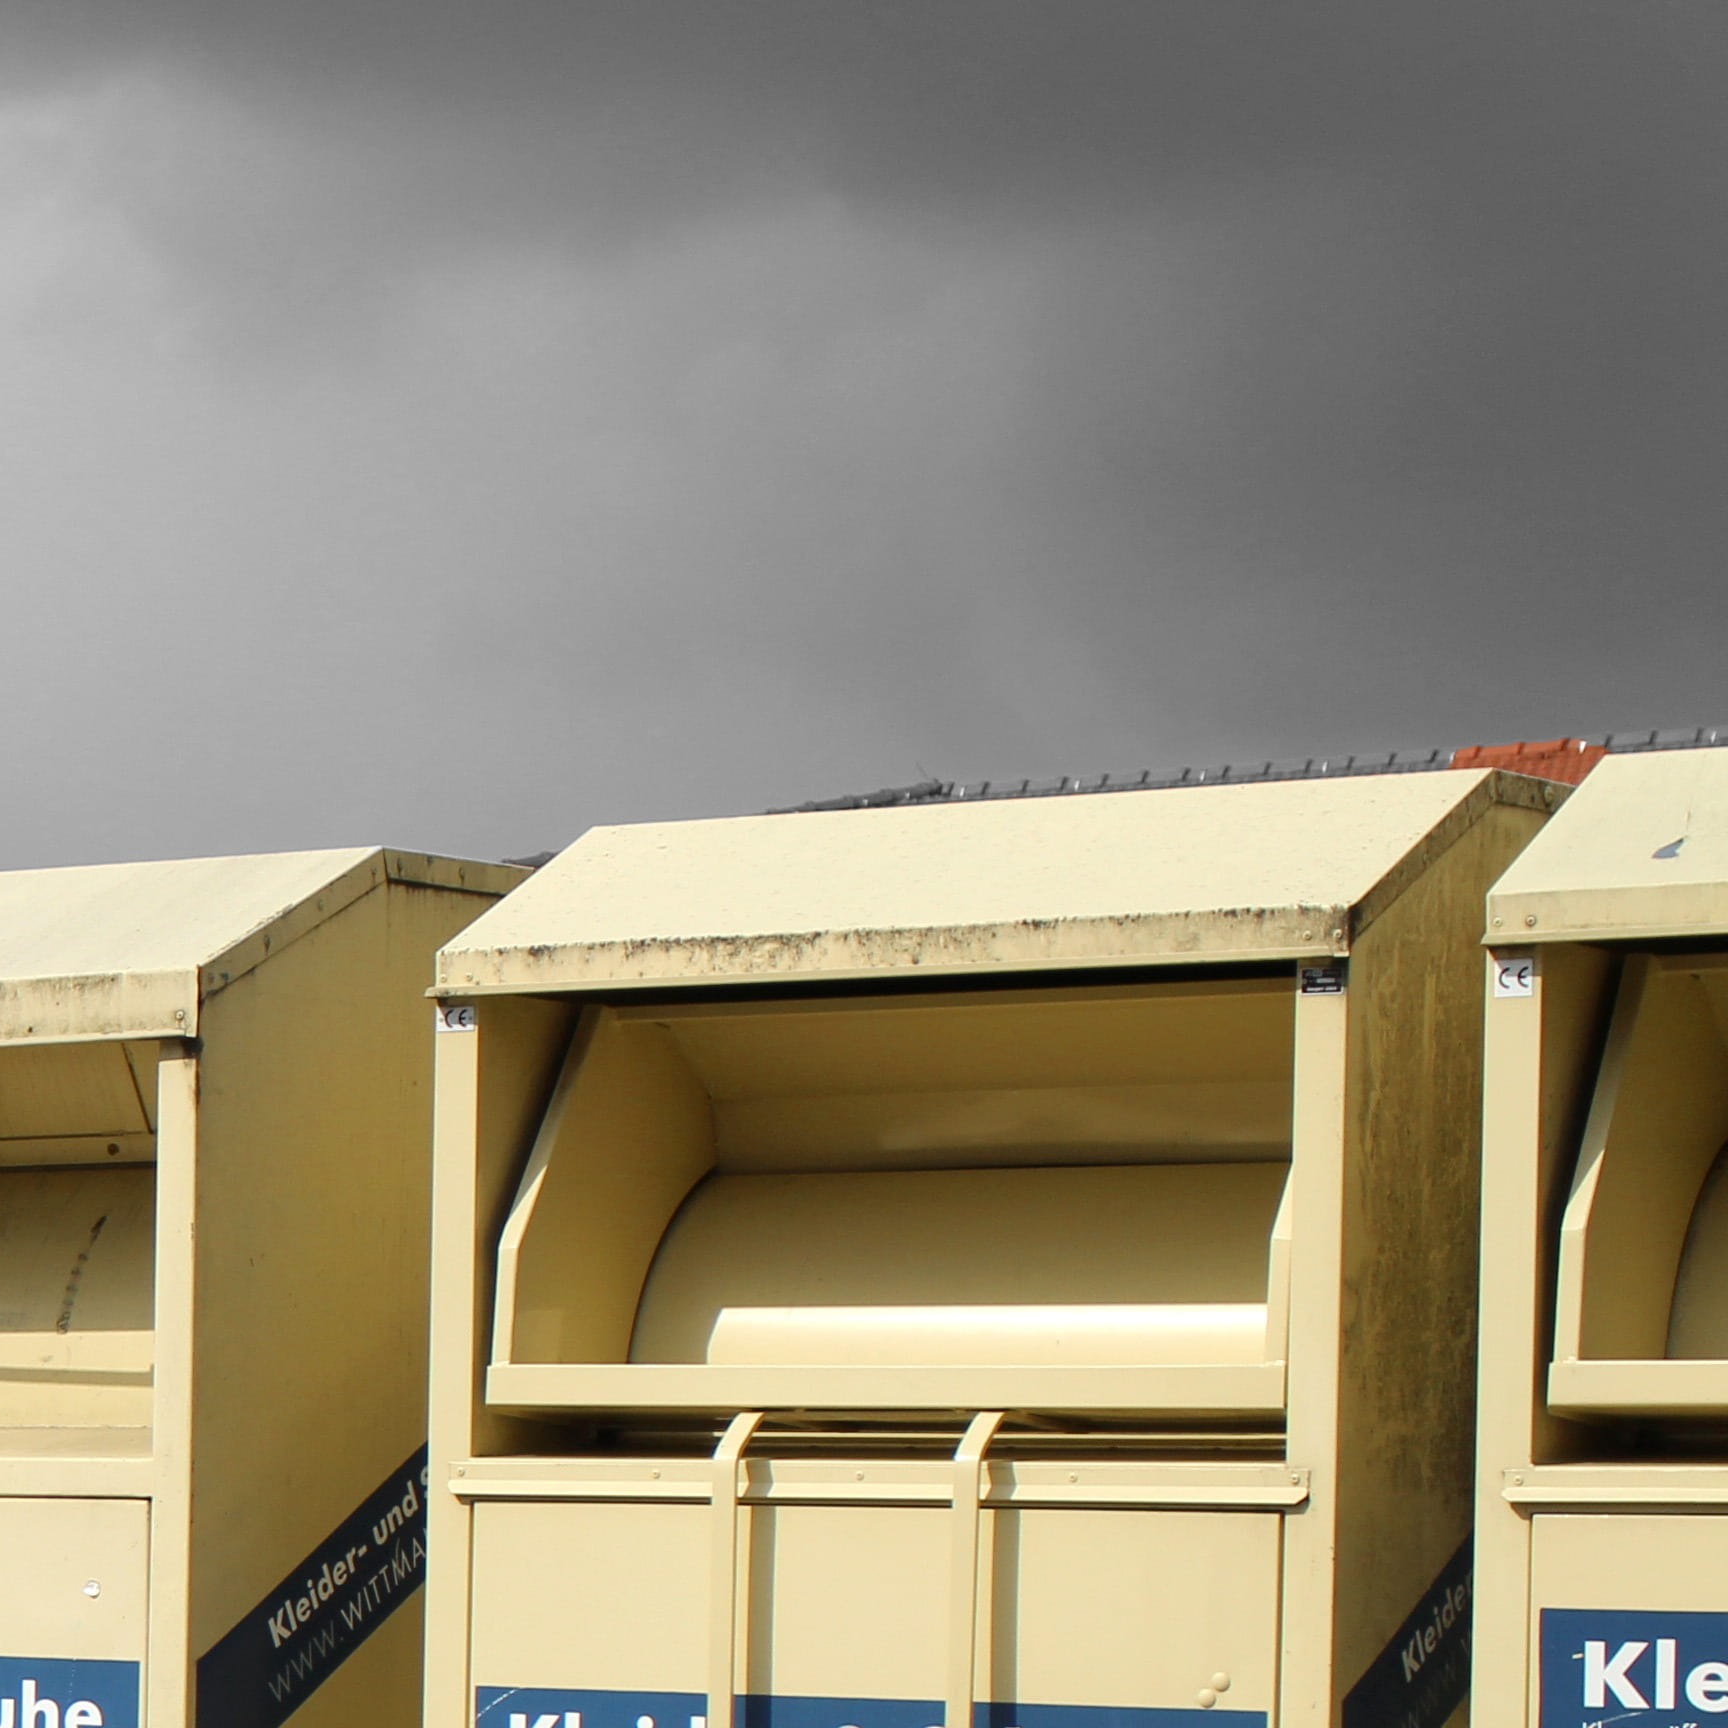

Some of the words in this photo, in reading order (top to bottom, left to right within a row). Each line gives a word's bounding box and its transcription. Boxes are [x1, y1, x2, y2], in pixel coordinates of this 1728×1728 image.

[268, 1545, 367, 1648] Kleider-
[372, 1480, 419, 1545] und
[268, 1527, 428, 1702] WWW.WITTMA
